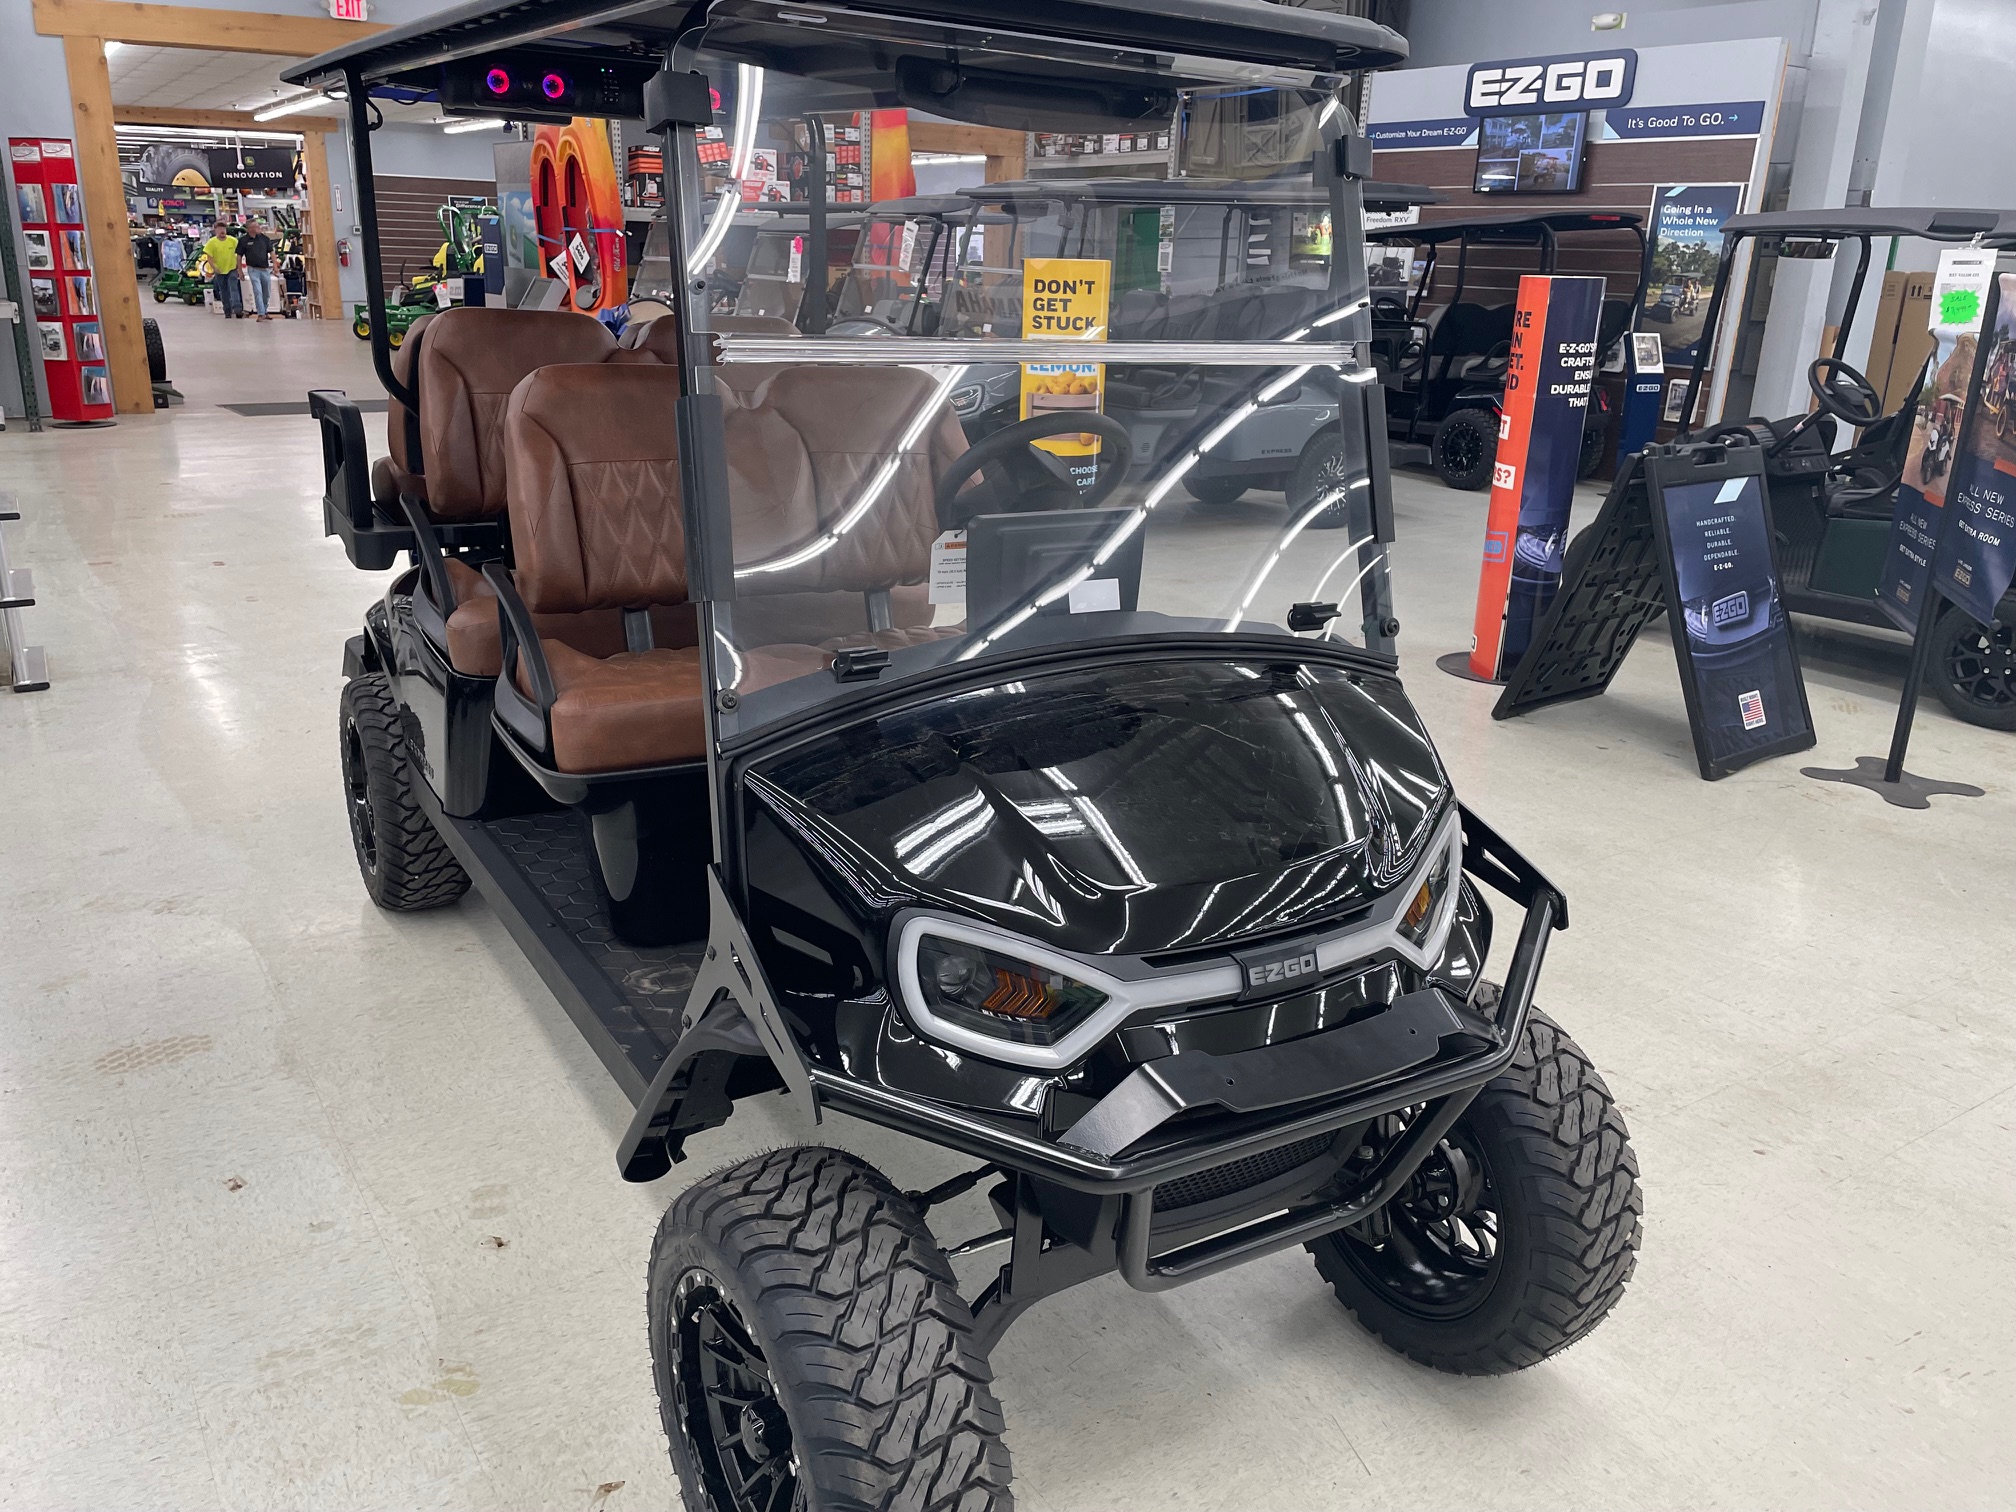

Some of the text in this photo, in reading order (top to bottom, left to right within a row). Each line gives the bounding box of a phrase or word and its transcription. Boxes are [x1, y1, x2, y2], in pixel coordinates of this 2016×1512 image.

[336, 0, 362, 18] EXIT
[1628, 112, 1724, 128] It's Good To GO.
[1422, 128, 1442, 136] Dream
[1664, 204, 1692, 216] Going
[1694, 204, 1704, 214] In
[1662, 216, 1718, 225] Whole New
[1660, 228, 1704, 236] Direction
[1034, 279, 1096, 295] DON'T
[1032, 297, 1072, 312] GET
[1032, 315, 1096, 330] STUCK
[1076, 477, 1095, 486] CART
[1983, 489, 2004, 505] NEW
[1696, 516, 1737, 527] HANDCRAFTED.
[1986, 507, 2014, 528] SERIES
[1704, 528, 1732, 537] RELIABLE.
[1706, 539, 1733, 549] DURABLE.
[1978, 532, 2000, 547] ROOM
[1704, 549, 1740, 561] DEPENDABLE.
